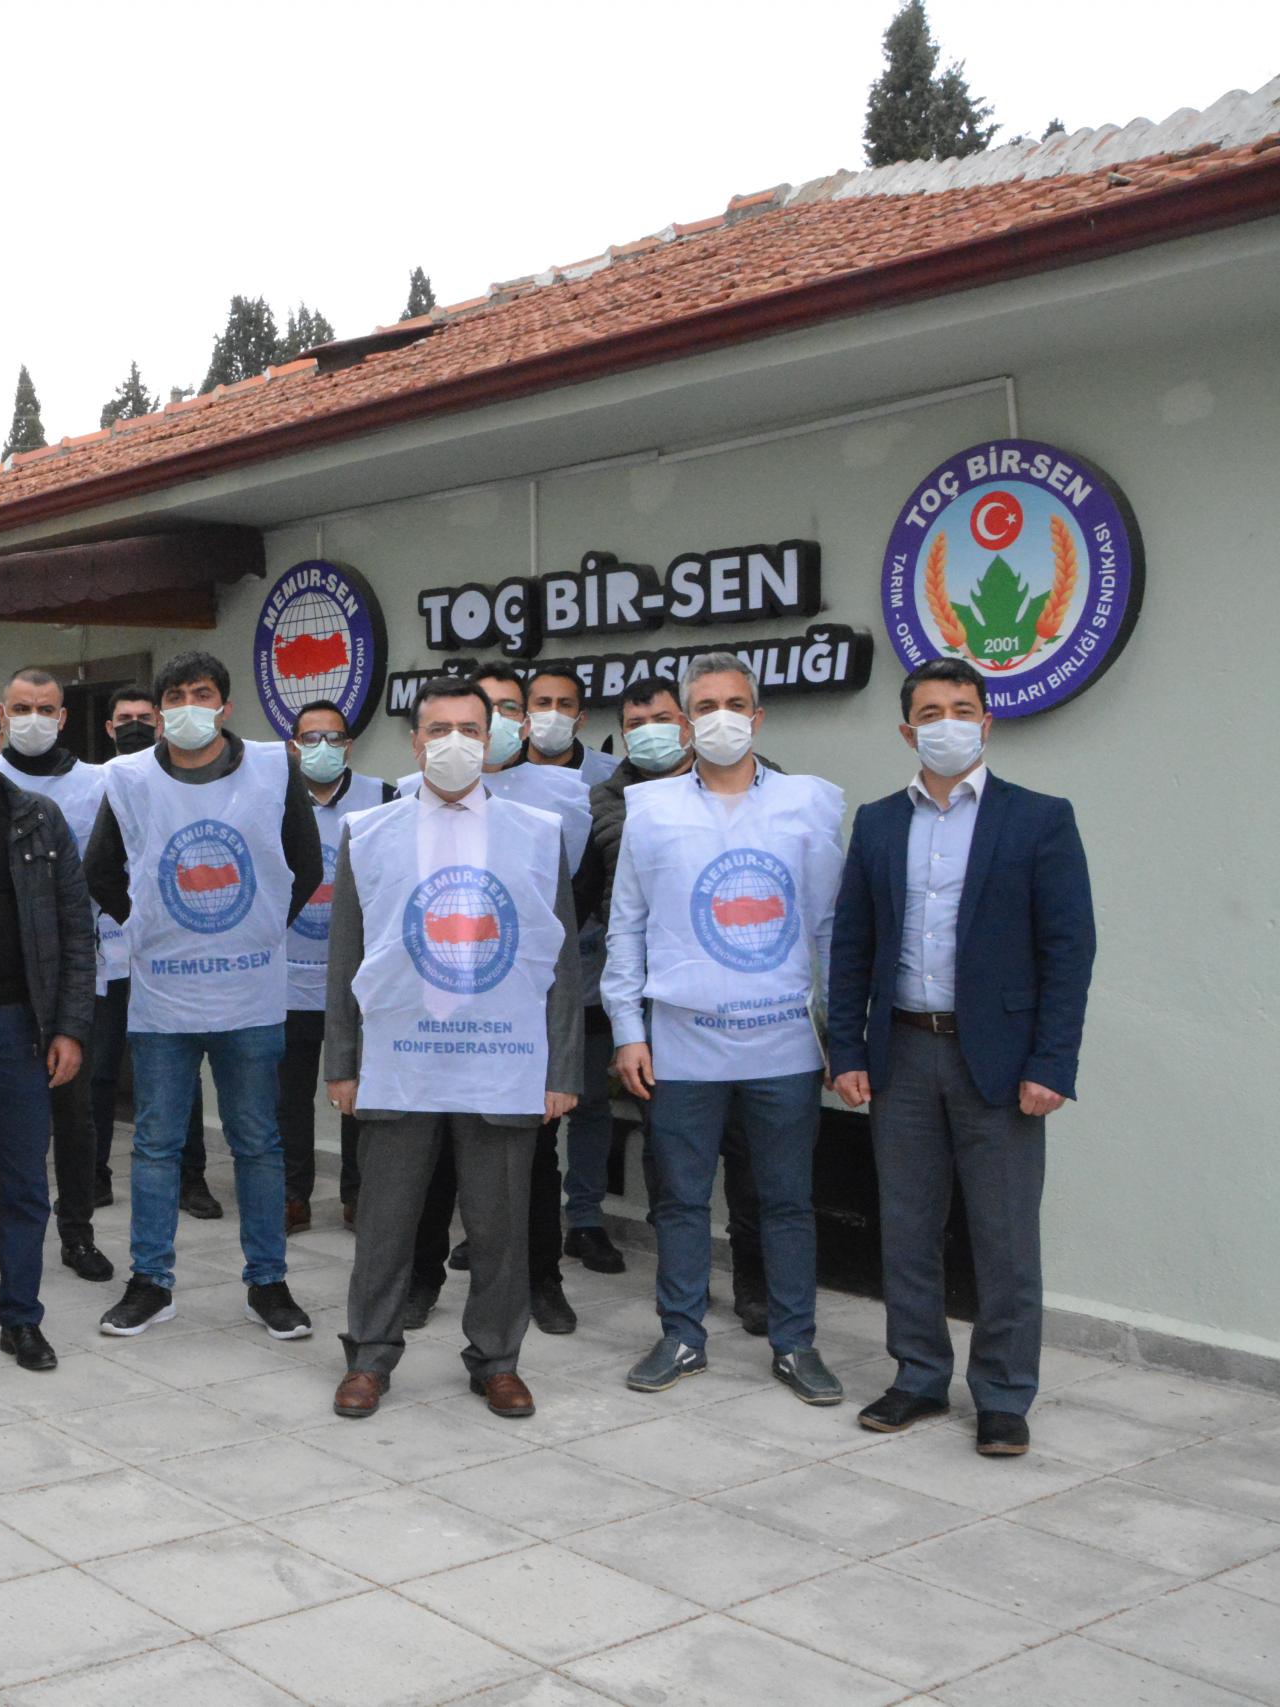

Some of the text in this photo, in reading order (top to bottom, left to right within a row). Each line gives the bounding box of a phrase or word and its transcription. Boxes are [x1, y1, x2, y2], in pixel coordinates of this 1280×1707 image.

[905, 446, 1094, 529] TOÇ BİR-SEN
[891, 553, 907, 609] TARIM
[1092, 522, 1116, 629] SENDİKASI
[263, 568, 359, 631] MEMUR-SEN
[423, 548, 799, 650] TOÇ BİR-SEN
[896, 622, 927, 668] ORMA
[983, 636, 1020, 654] 2001
[1048, 630, 1101, 689] BİRLİĞİ
[260, 650, 271, 701] MEMUR
[268, 699, 294, 734] SENDİK
[341, 637, 364, 717] DERASYONU
[985, 681, 1047, 708] ANLARI
[169, 824, 244, 862] MEMUR-SEN
[413, 871, 508, 909] MEMUR-SEN
[699, 854, 790, 895] MEMUR-SEN
[151, 950, 272, 976] MEMUR-SEN
[392, 1040, 535, 1055] KONFEDERASYONU
[418, 1020, 513, 1034] MEMUR-SEN
